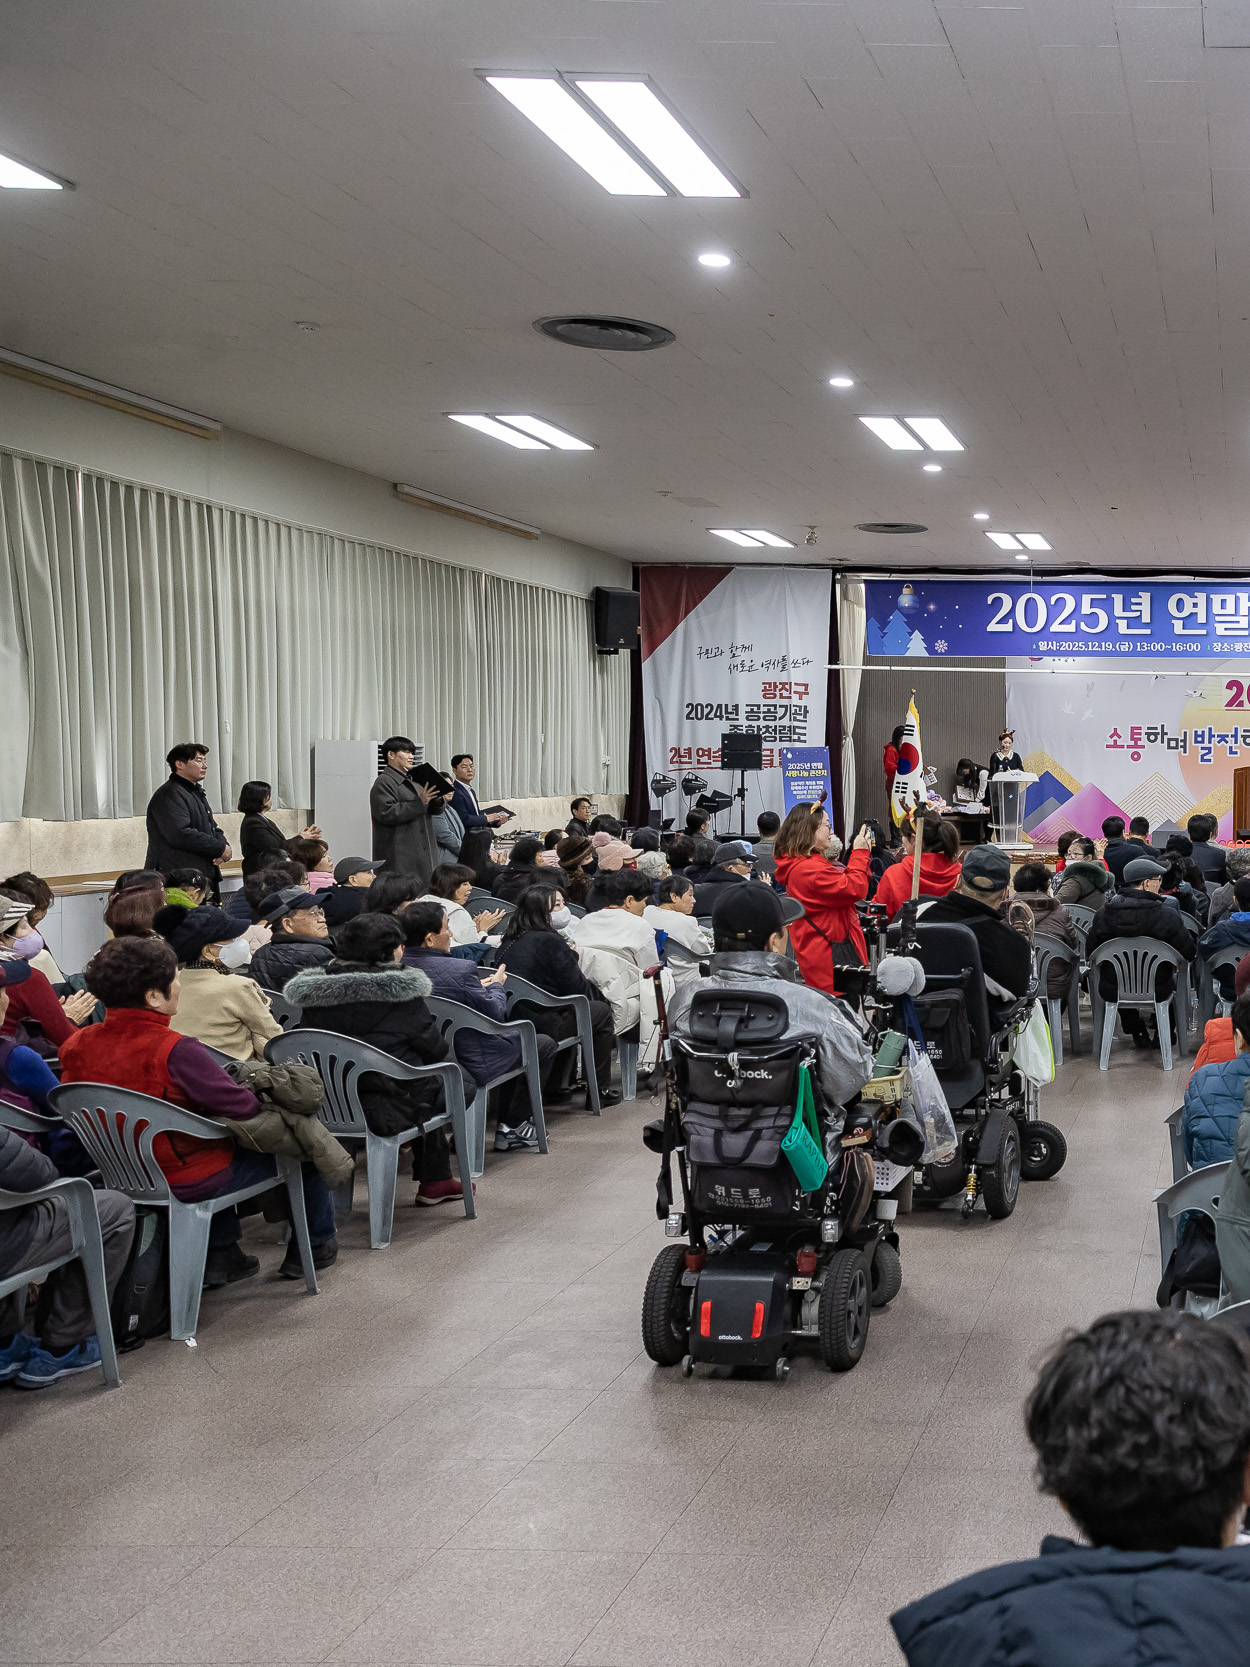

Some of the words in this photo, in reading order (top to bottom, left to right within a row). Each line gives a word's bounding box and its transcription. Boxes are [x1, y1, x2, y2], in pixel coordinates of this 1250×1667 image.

[986, 592, 1151, 635] 2025년
[728, 642, 753, 660] 함께
[728, 659, 760, 674] 새로운
[761, 655, 788, 673] 역사를
[761, 681, 810, 700] 광진구
[685, 702, 739, 721] 2024년
[744, 703, 810, 723] 공공기관
[1105, 724, 1188, 762] 소통하며
[669, 747, 692, 765] 2년
